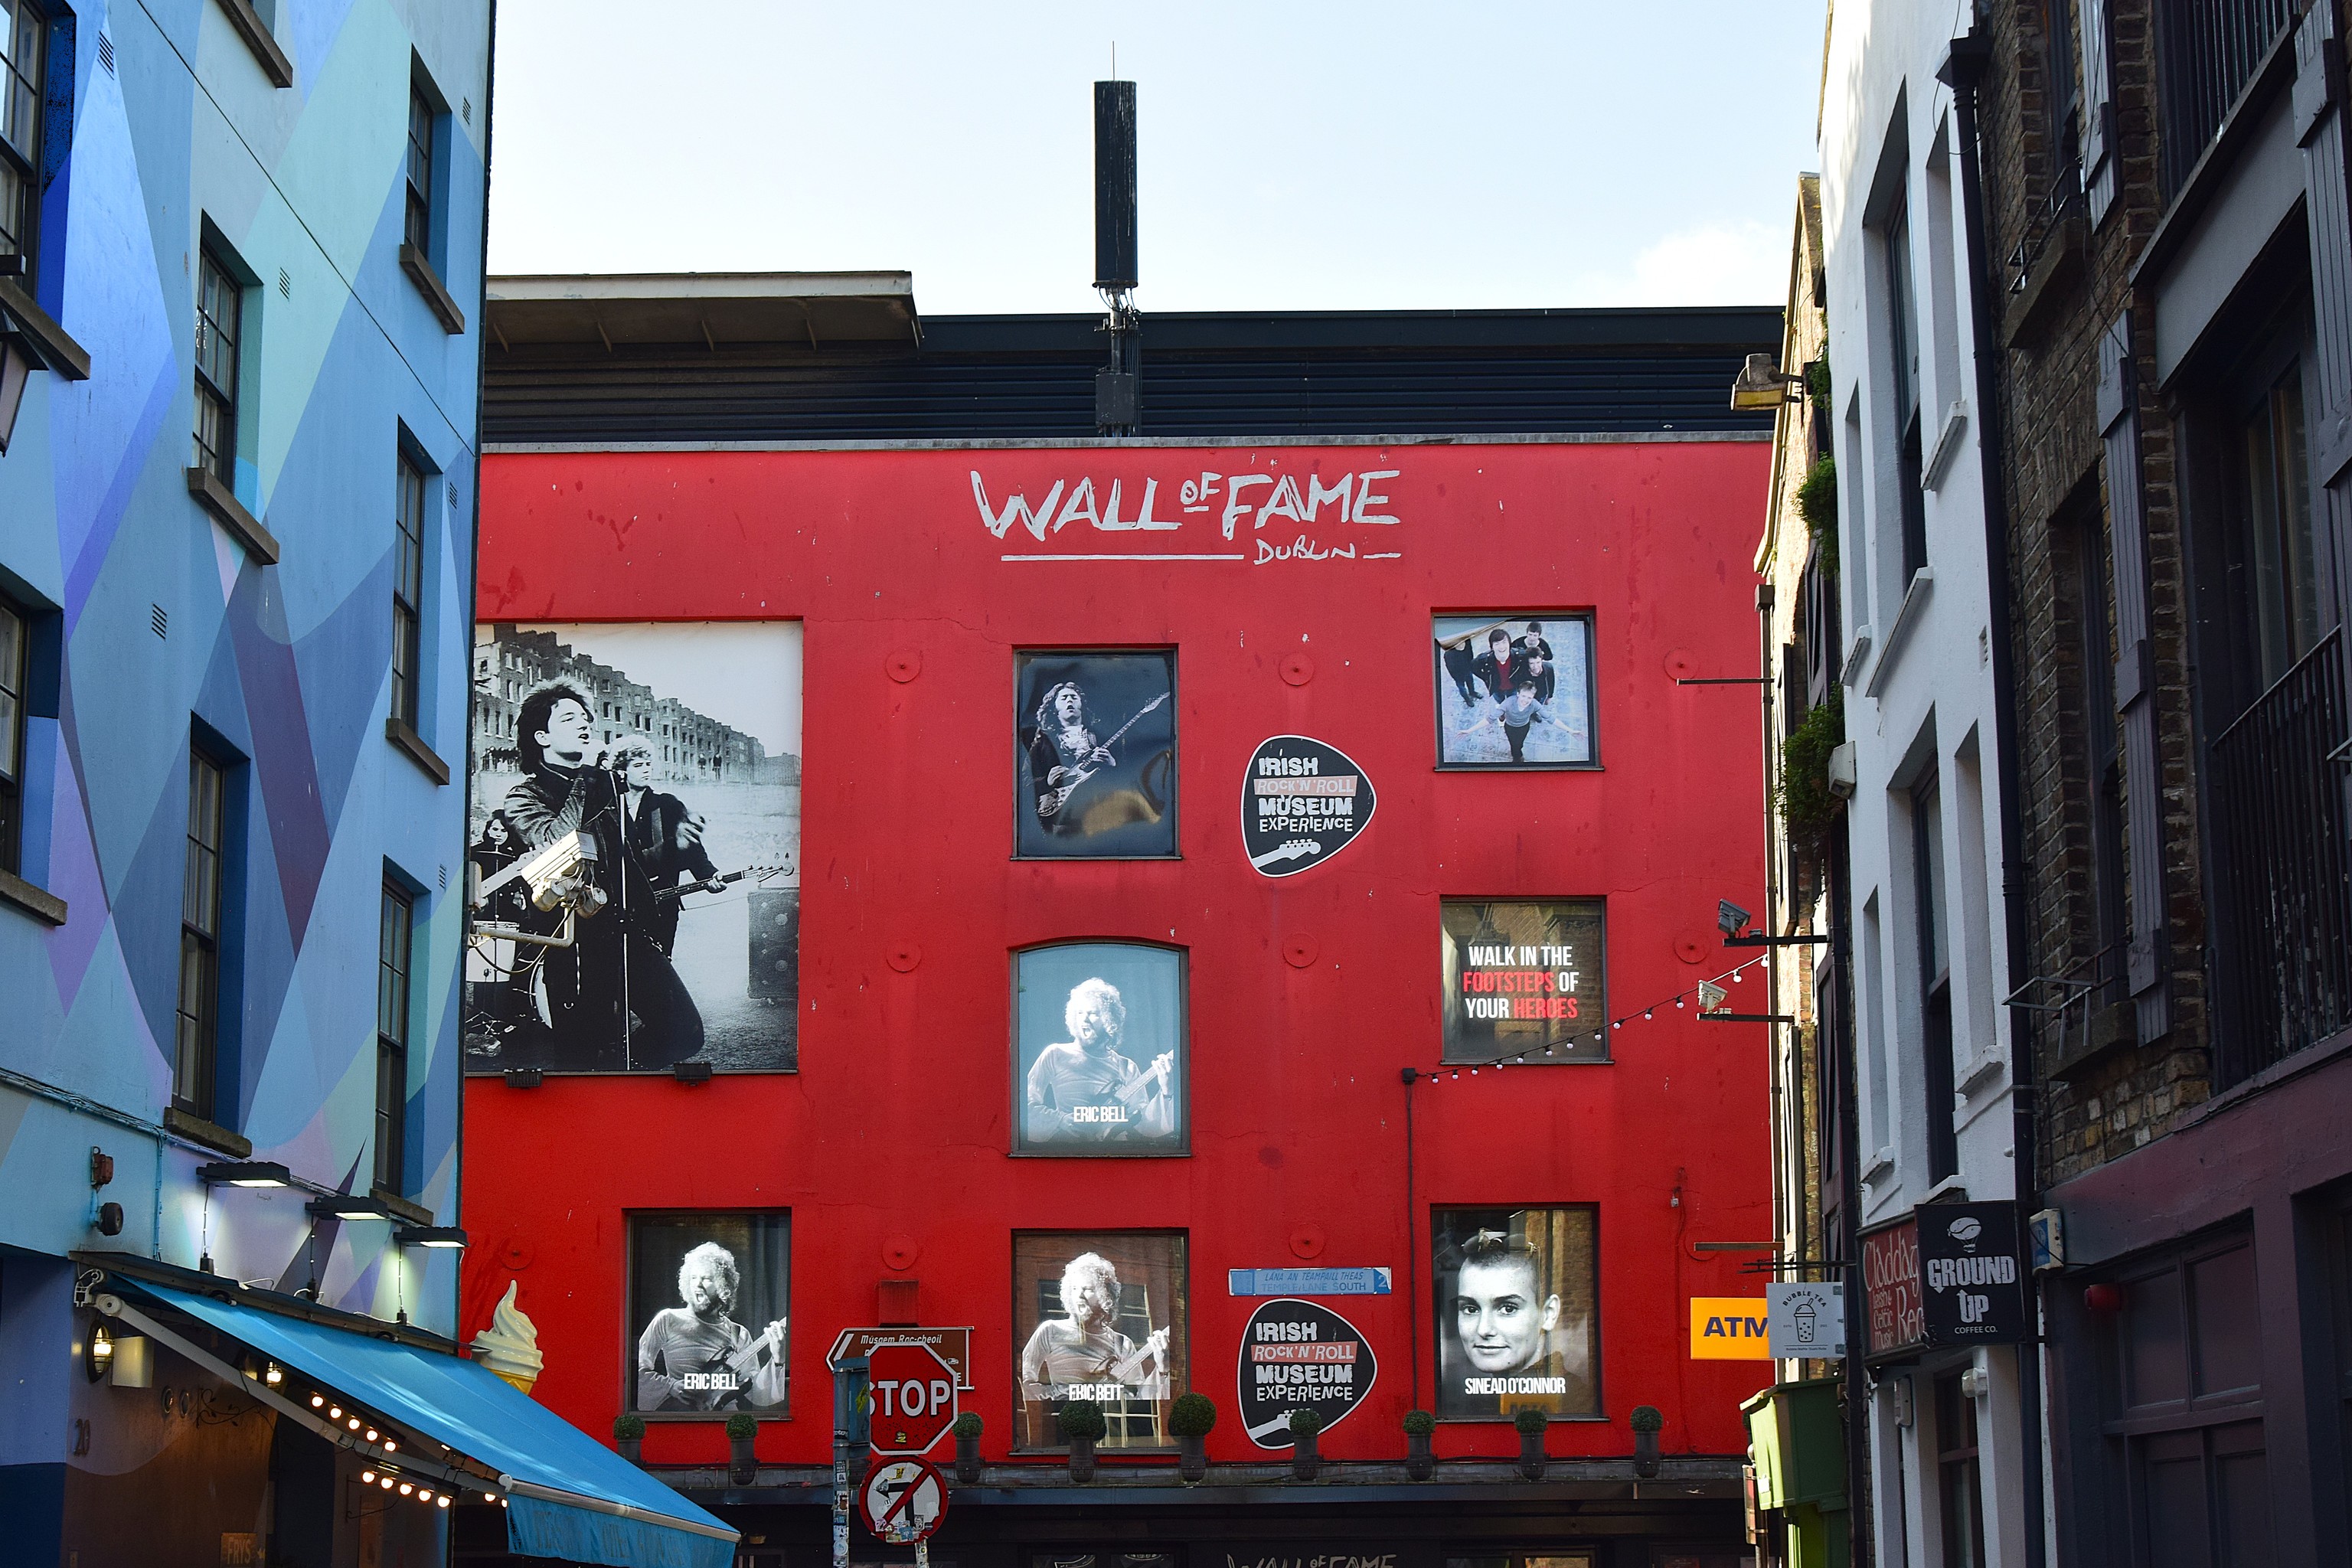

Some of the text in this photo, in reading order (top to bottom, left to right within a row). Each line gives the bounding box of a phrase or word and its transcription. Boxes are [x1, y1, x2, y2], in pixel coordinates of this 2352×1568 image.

[971, 470, 1400, 541] WALL OF FAME
[1259, 756, 1318, 776] IRISH
[1258, 797, 1353, 816] MUSEUM
[1259, 816, 1353, 833] EXPERIENCE
[1468, 946, 1573, 966] WALK IN THE
[1463, 972, 1579, 992] FOOTSTEPS OF
[1465, 998, 1578, 1019] YOUR HEROES
[1073, 1106, 1129, 1122] ERIC BELL
[1863, 1228, 1919, 1297] Claddag
[1288, 1272, 1298, 1281] AN
[1302, 1272, 1340, 1281] TEAMPAILL
[1341, 1271, 1364, 1279] THEAS
[1927, 1256, 2016, 1293] GROUND
[1333, 1282, 1366, 1291] SOUTH
[1782, 1291, 1827, 1307] BUBBLE TEA
[1956, 1289, 1989, 1323] UP
[1704, 1316, 1769, 1338] ATM
[1873, 1308, 1893, 1330] Celtic
[1256, 1322, 1317, 1341] IRISH
[1984, 1325, 1998, 1334] CO.
[684, 1373, 740, 1390] ERIC BELL
[1256, 1364, 1353, 1384] MUSEUM
[1256, 1384, 1353, 1402] EXPERIENCE
[1465, 1377, 1566, 1394] SINEAD O'CONNOR
